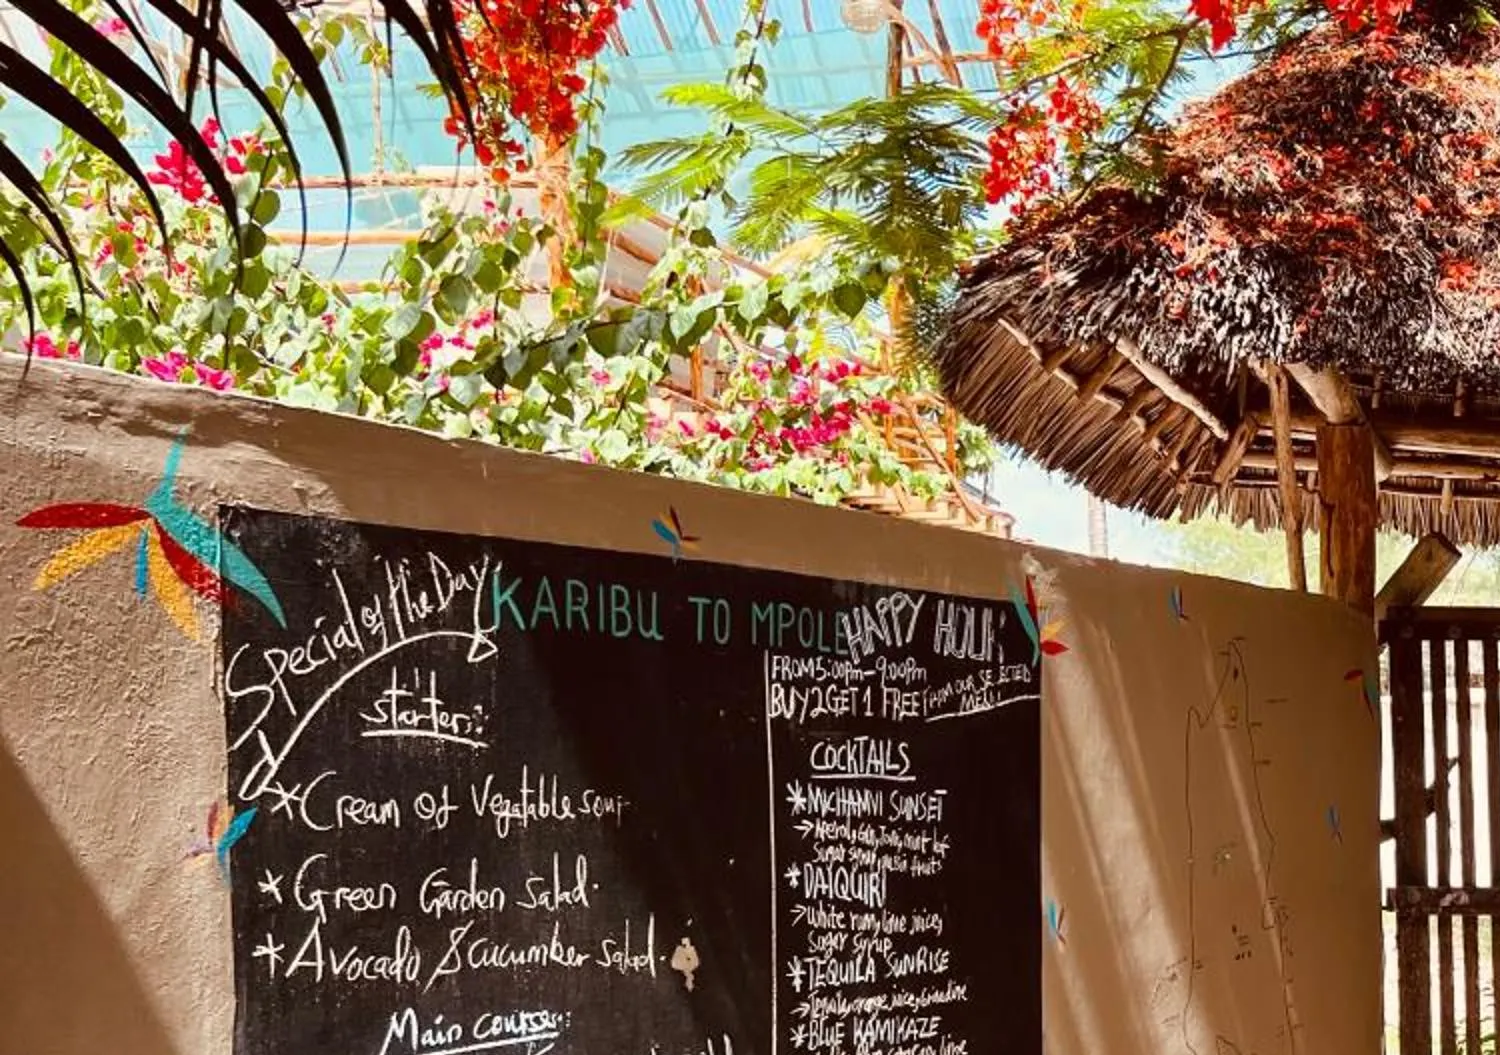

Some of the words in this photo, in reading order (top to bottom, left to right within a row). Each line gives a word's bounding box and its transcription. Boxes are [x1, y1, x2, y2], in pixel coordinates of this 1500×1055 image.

[491, 570, 663, 641] KARIBU
[688, 596, 731, 646] TO
[842, 590, 926, 664] HAPPY
[225, 567, 365, 752] Special
[770, 655, 815, 682] FROM
[767, 683, 808, 724] BUY
[809, 685, 829, 720] 2
[825, 684, 859, 718] GET
[863, 685, 874, 716] 1
[883, 687, 922, 722] FREE
[810, 736, 911, 777] COCKTAILS
[300, 771, 400, 831] Cream
[888, 789, 948, 823] SUNSET
[295, 853, 397, 923] Green
[419, 856, 505, 919] Garden
[285, 916, 421, 982] Avocado
[804, 953, 877, 991] TEQUILA
[886, 945, 950, 979] SUNRISE
[808, 1016, 846, 1051] BLUE
[853, 1014, 943, 1048] KAMIKAZE
